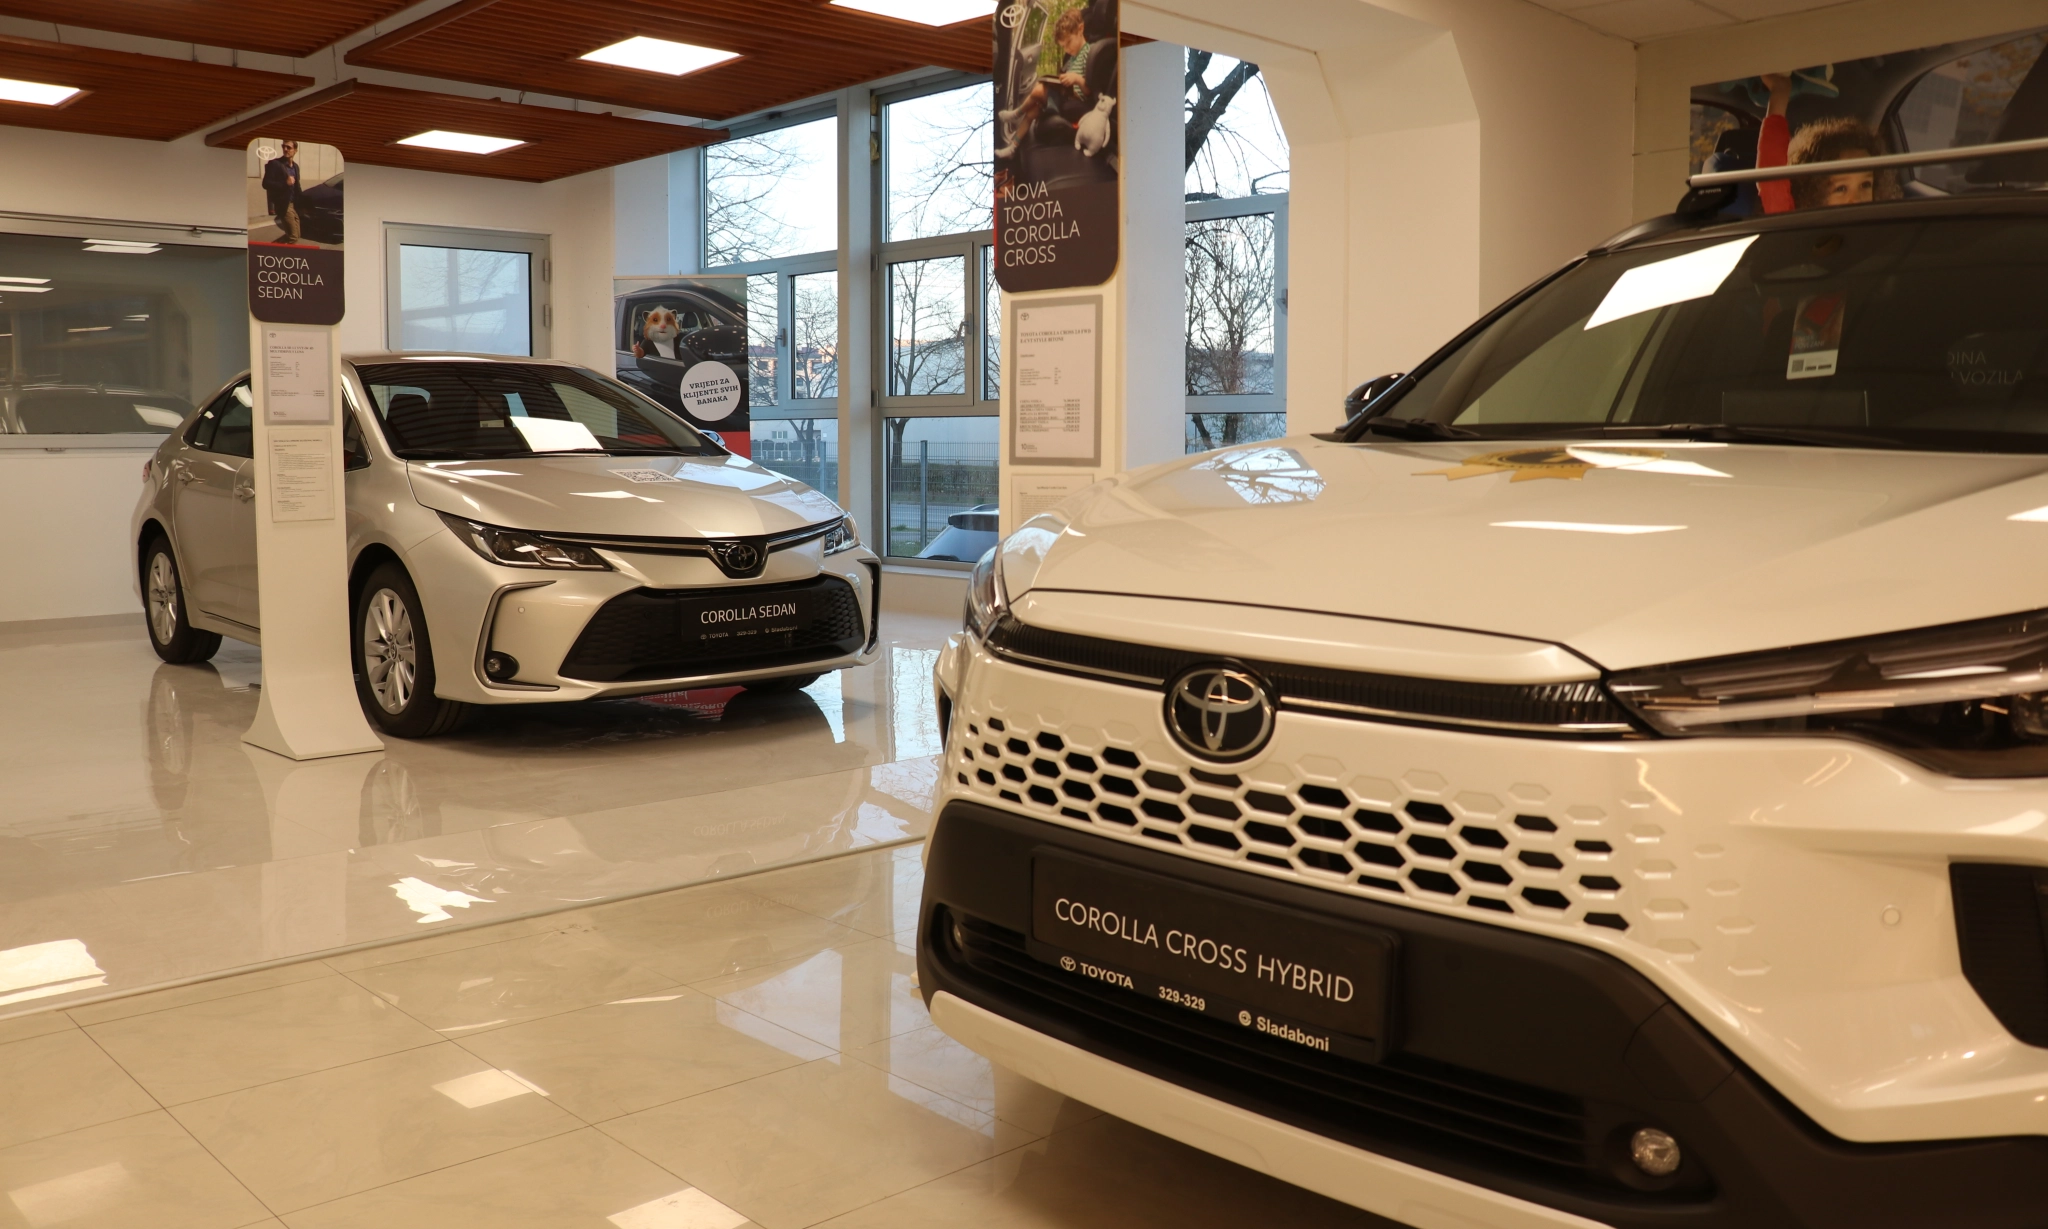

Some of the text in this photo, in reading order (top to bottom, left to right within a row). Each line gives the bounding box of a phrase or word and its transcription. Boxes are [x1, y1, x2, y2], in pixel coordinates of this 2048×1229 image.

[1004, 180, 1048, 203] NOVA
[1003, 200, 1063, 224] TOYOTA
[1004, 220, 1080, 246] COROLLA
[257, 254, 310, 270] TOYOTA
[1004, 244, 1056, 267] CROSS
[257, 270, 324, 286] COROLLA
[258, 286, 303, 300] SEDAN
[683, 385, 739, 399] KLIJENTE SVIH
[689, 380, 719, 389] VRIJEDI
[697, 395, 728, 405] BANAKA
[700, 603, 796, 624] COROLLA SEDAN
[771, 625, 798, 633] Sladaboni
[1055, 898, 1354, 1002] COROLLA CROSS HYBRID
[1080, 962, 1330, 1052] TOYOTA 329-329 Sladaboni
